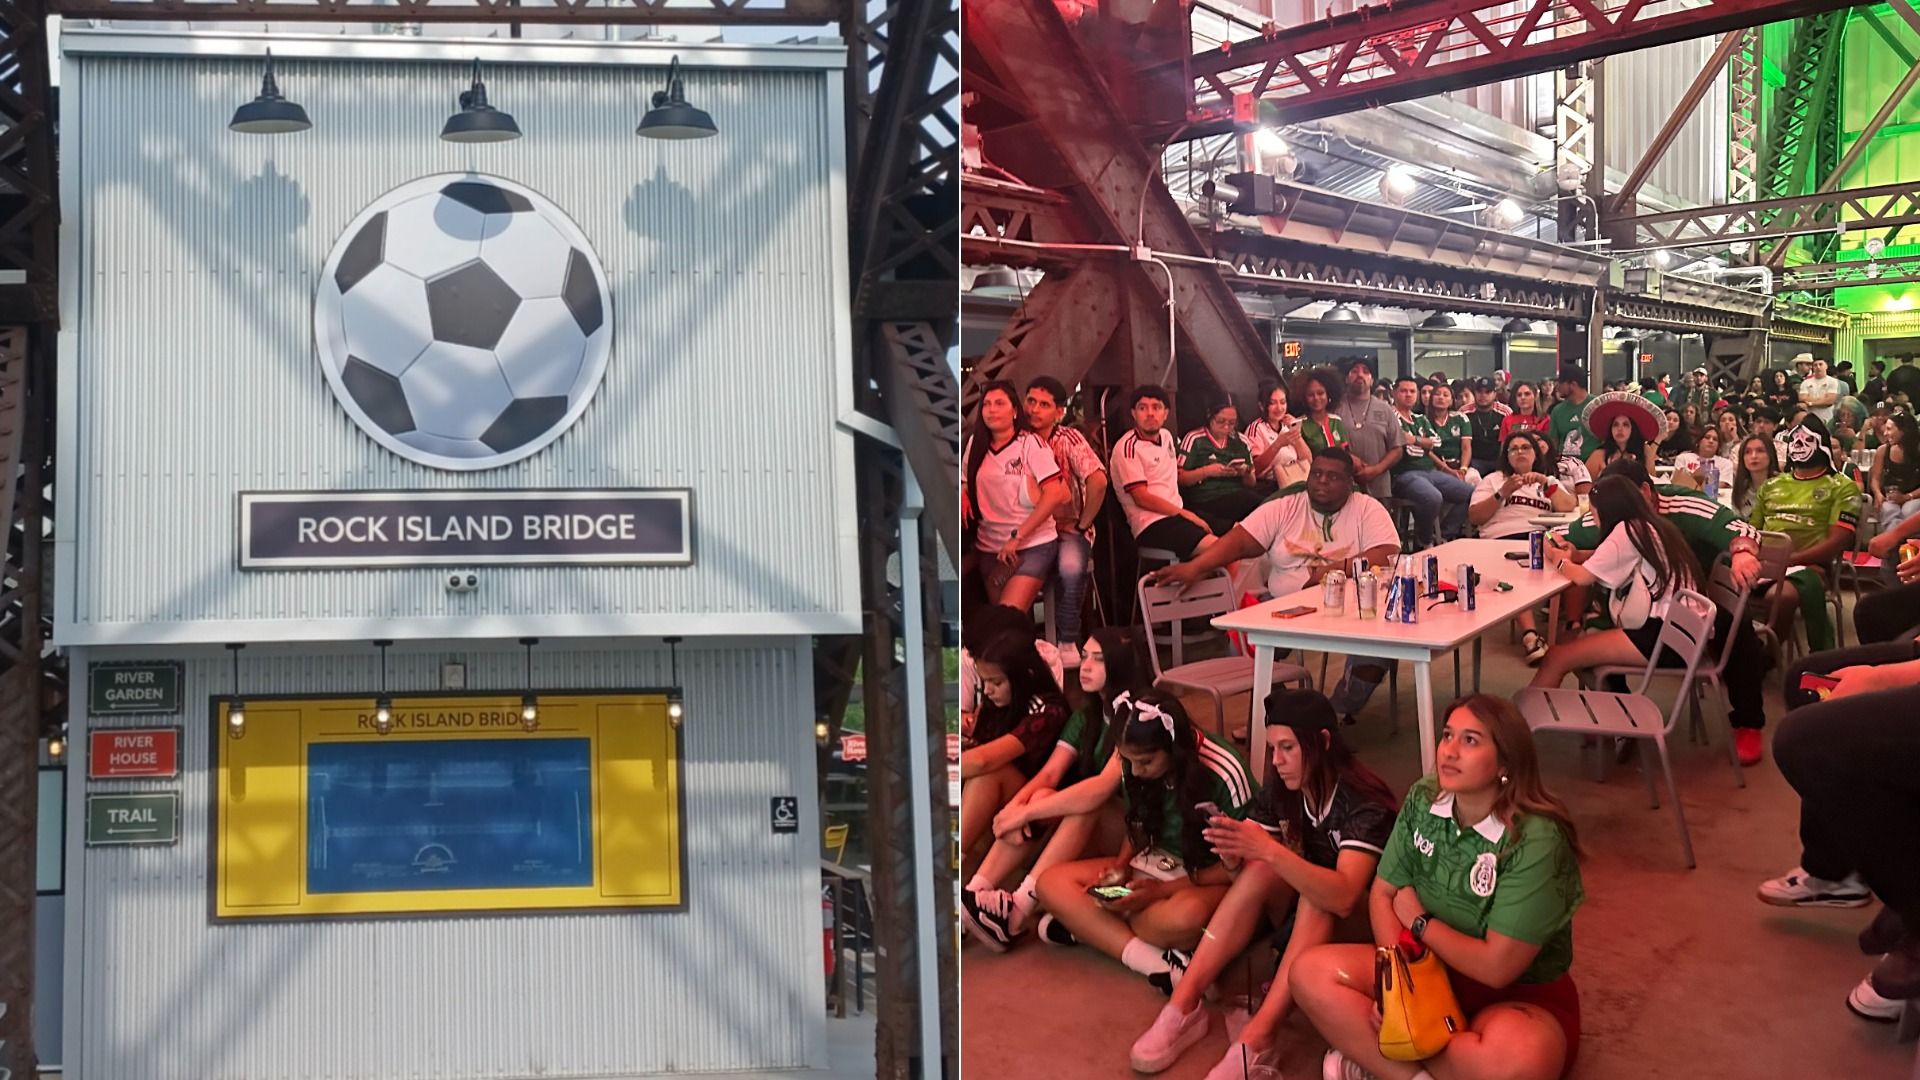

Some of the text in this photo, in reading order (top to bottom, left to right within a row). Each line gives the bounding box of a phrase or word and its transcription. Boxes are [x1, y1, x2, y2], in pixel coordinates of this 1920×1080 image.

[298, 514, 636, 543] ROCK ISLAND BRIDGE
[115, 671, 155, 684] RIVER
[105, 687, 164, 701] GARDEN
[358, 710, 541, 728] ROK ISLAND BRID
[114, 735, 154, 748] RIVER
[109, 752, 158, 765] HOUSE
[107, 808, 157, 823] TRAIL
